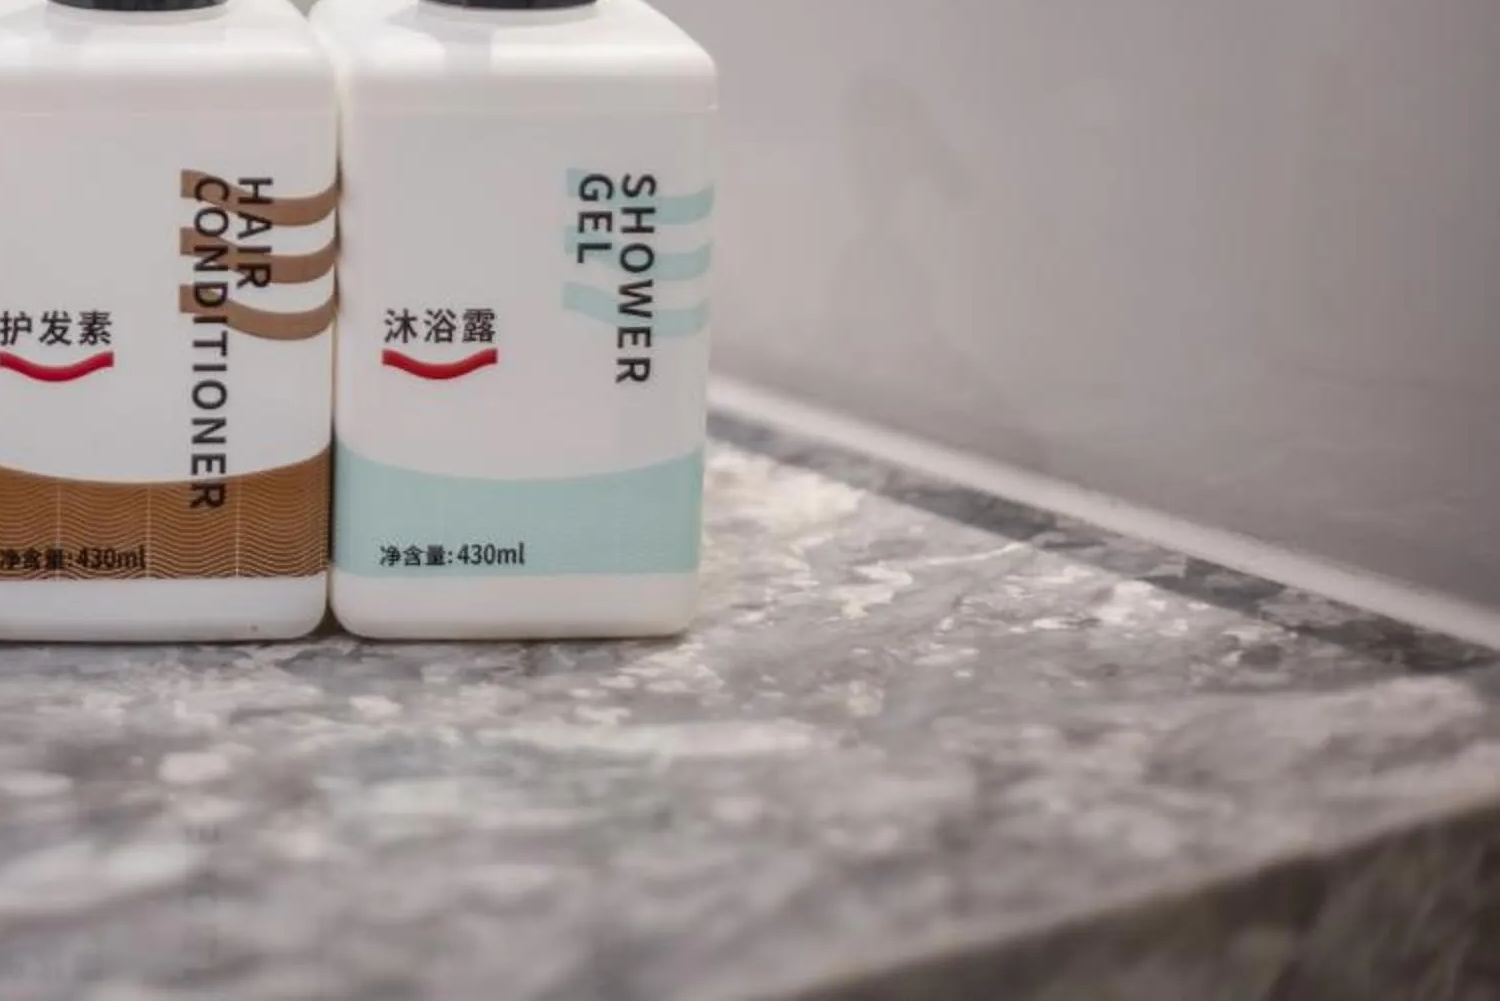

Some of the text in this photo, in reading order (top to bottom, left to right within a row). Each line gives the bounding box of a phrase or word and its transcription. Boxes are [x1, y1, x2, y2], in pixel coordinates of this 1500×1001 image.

[237, 177, 274, 289] HAIR
[577, 173, 614, 264] GEL
[382, 308, 496, 344] 沐浴露
[615, 173, 657, 384] SHOWER
[189, 176, 230, 509] CONDITIONER
